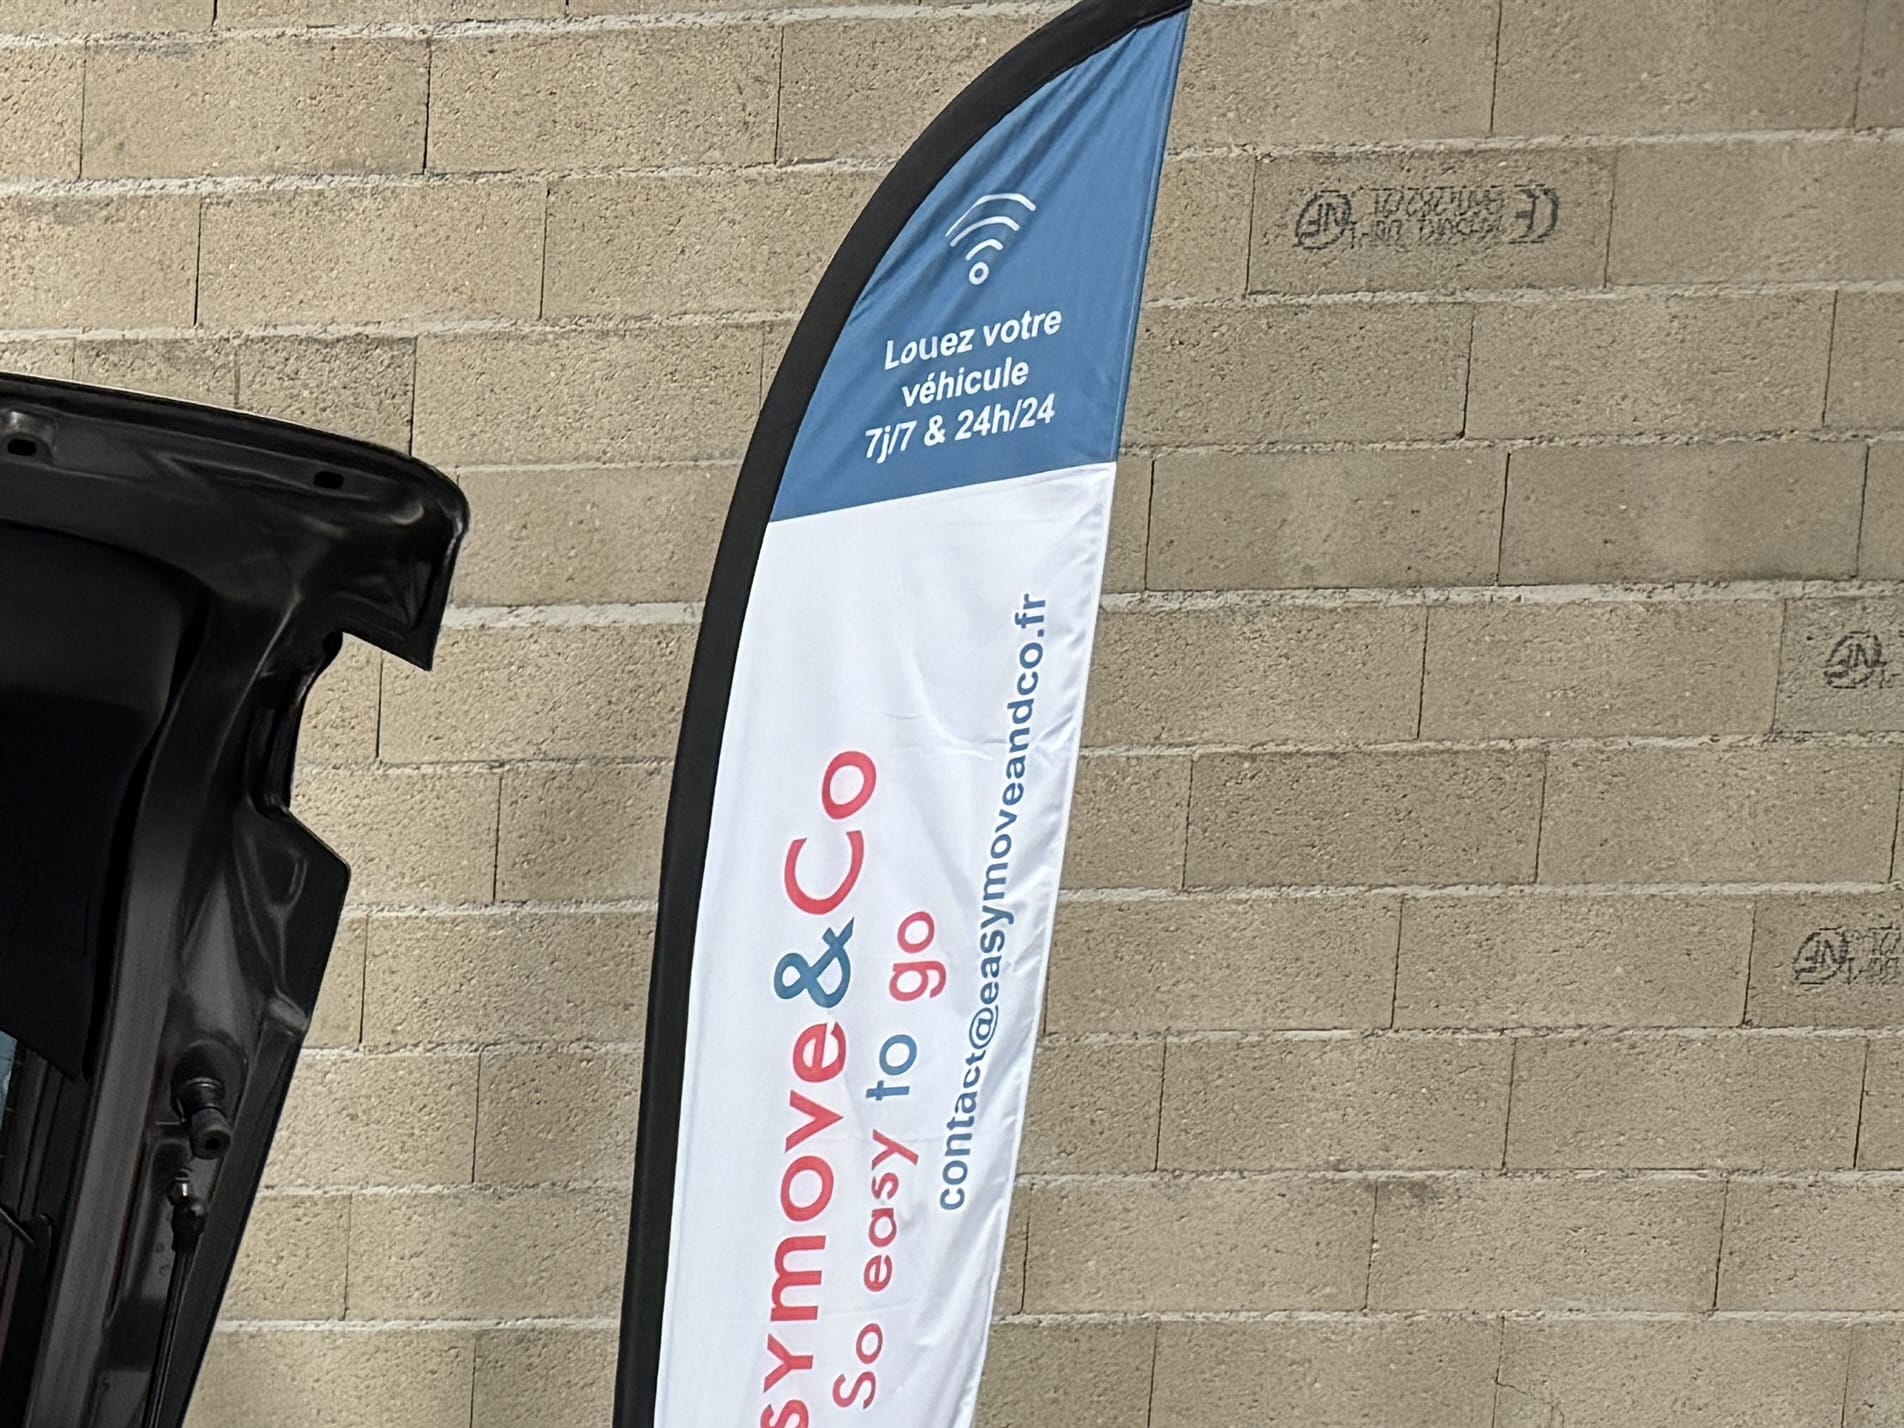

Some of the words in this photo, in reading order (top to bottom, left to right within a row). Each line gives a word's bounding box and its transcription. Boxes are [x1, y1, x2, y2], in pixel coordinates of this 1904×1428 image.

[883, 328, 974, 370] Louez
[982, 309, 1062, 347] votre
[901, 356, 1030, 409] véhicule
[864, 419, 915, 464] 7j/7
[923, 415, 946, 447] &
[955, 392, 1056, 441] 24h/24
[940, 594, 1047, 1212] contact@easymoveandco.fr
[889, 910, 947, 1002] go
[865, 1033, 919, 1102] to
[864, 1129, 919, 1293] easy
[833, 1323, 883, 1409] So
